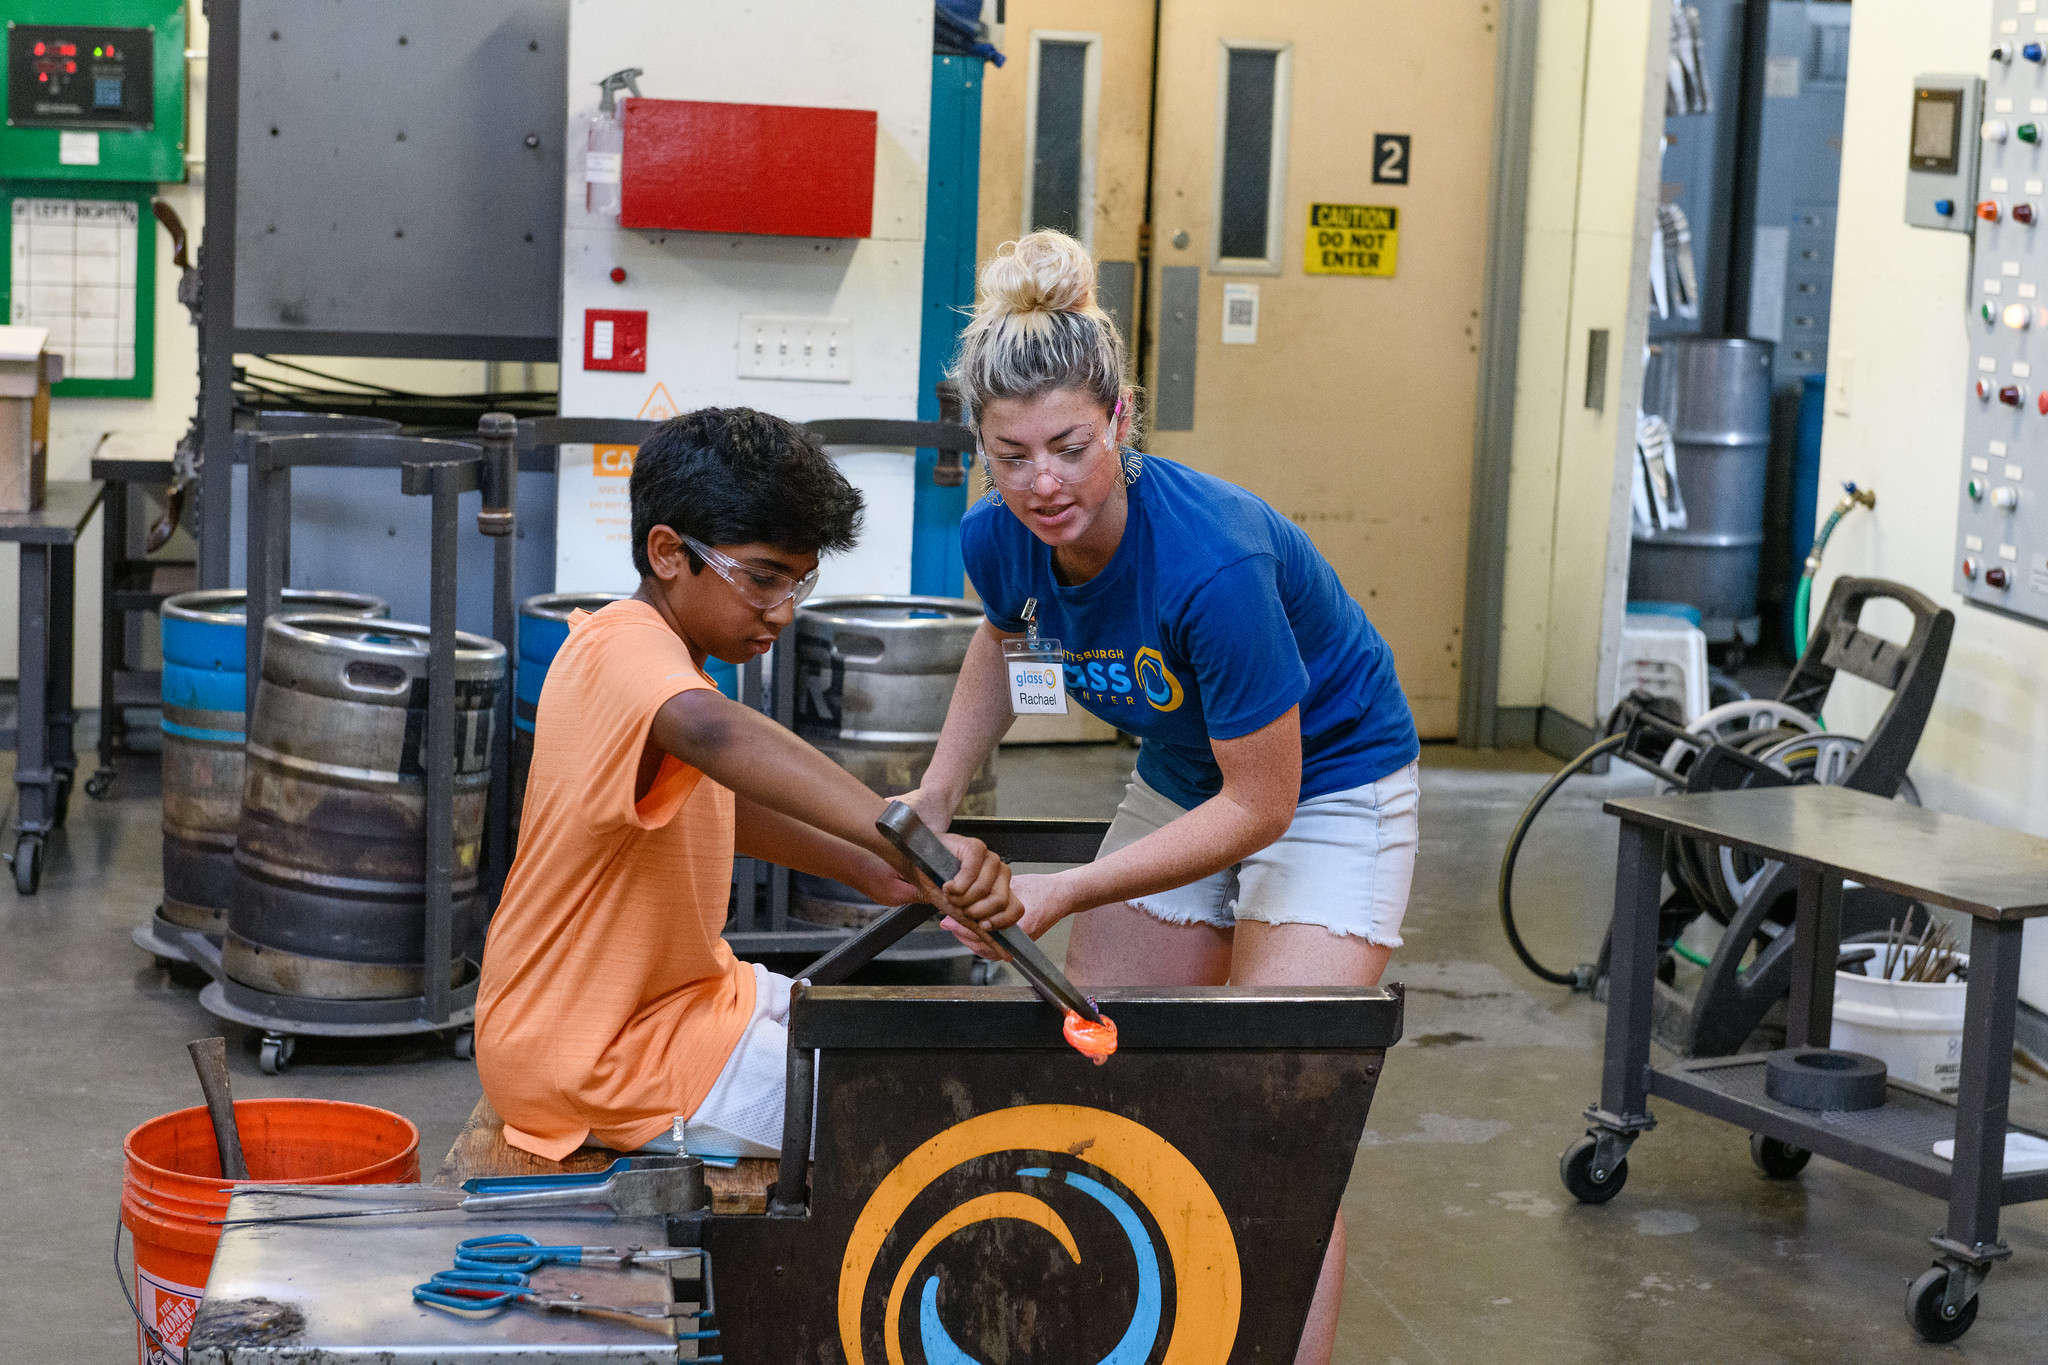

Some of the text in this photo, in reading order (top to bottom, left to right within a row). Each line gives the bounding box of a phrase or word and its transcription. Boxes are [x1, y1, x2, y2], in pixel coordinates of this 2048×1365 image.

[1379, 139, 1404, 179] 2
[1317, 206, 1391, 229] CAUTION
[1318, 231, 1386, 250] DO NOT
[1322, 251, 1379, 268] ENTER
[1062, 648, 1124, 662] ITTSBURGH
[1016, 670, 1044, 688] glass
[1063, 661, 1133, 694] ass
[1019, 692, 1058, 706] Rachael
[158, 1297, 175, 1317] THE
[157, 1298, 196, 1340] HOME
